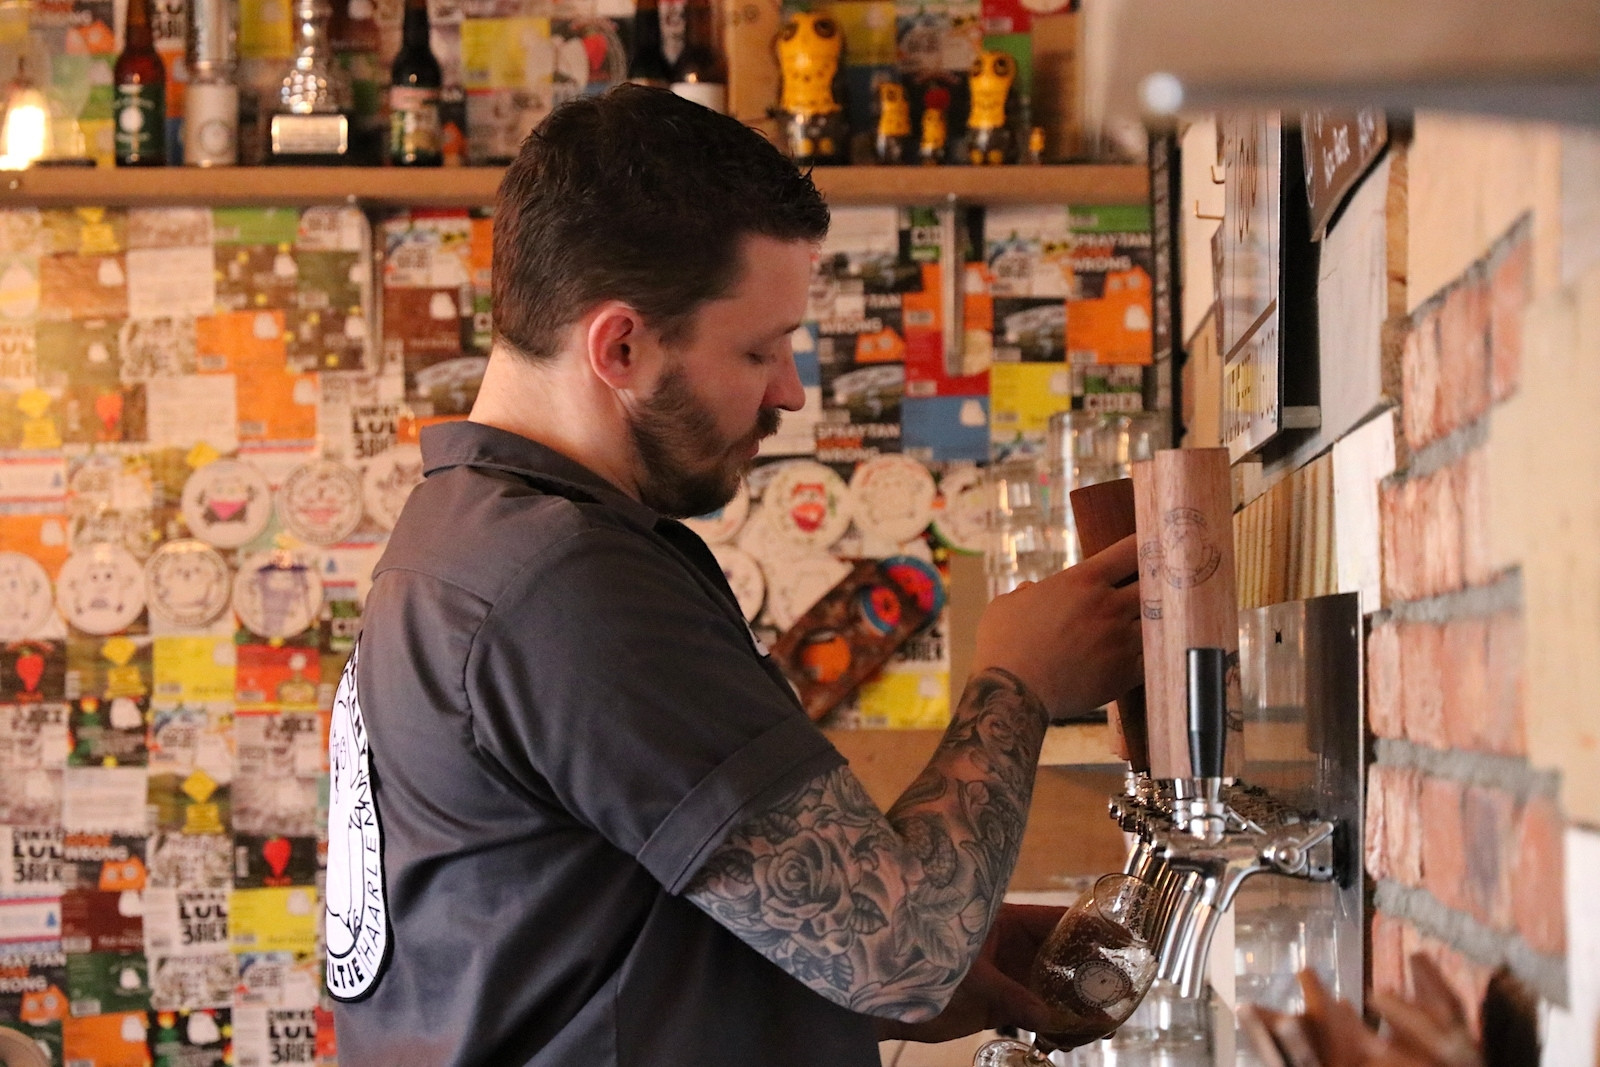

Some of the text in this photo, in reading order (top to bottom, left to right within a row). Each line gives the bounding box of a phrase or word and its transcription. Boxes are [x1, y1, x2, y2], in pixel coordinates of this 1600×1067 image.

[13, 843, 63, 859] LUL
[180, 905, 228, 920] LUL
[327, 957, 365, 989] ILTJE
[0, 975, 47, 992] RONG
[269, 1024, 315, 1039] LUL
